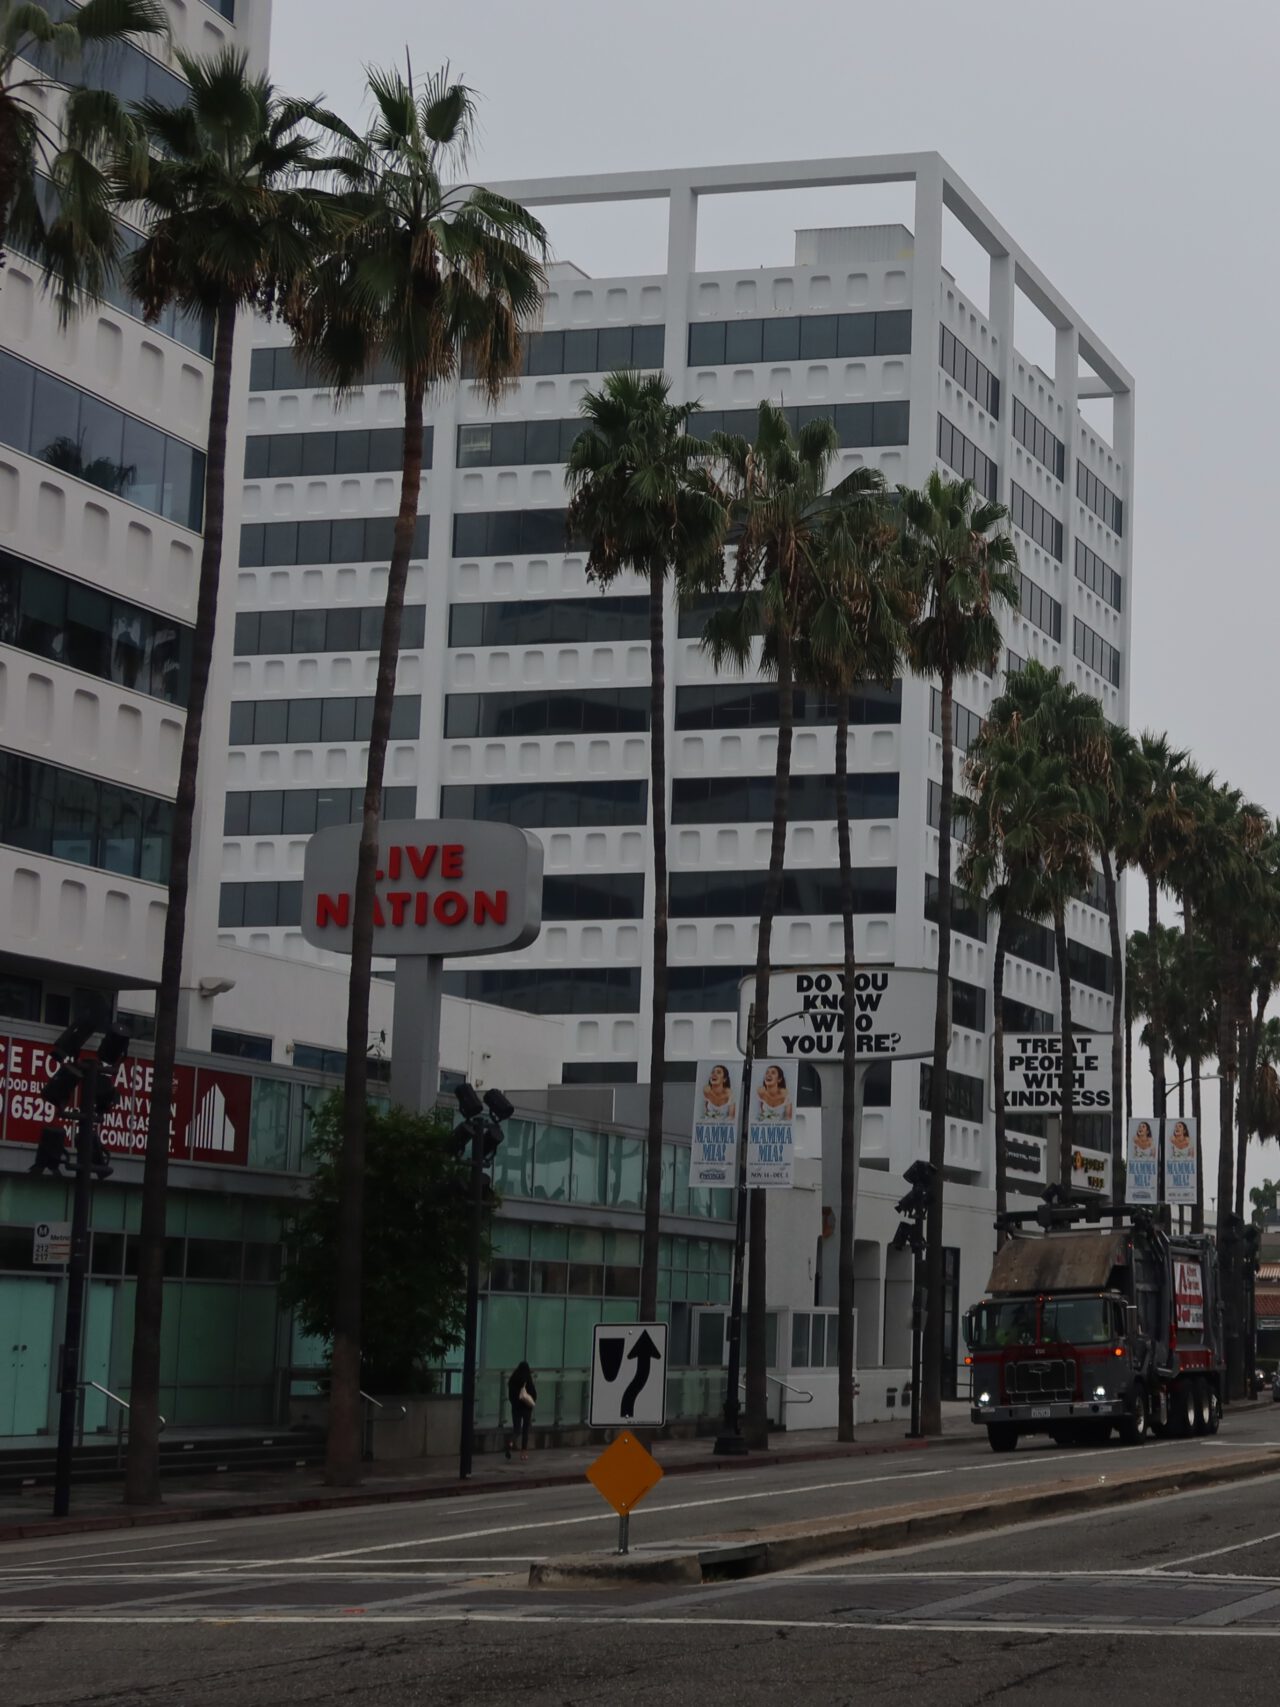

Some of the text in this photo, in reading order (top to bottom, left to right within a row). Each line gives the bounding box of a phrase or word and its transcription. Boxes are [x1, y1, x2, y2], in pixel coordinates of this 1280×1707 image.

[376, 844, 464, 881] IVE
[796, 974, 833, 993] DO
[782, 1035, 833, 1054] YOU
[31, 1049, 75, 1079] FO
[11, 1094, 56, 1124] 6529
[695, 1126, 735, 1144] MAMMA
[750, 1126, 793, 1145] MAMMA
